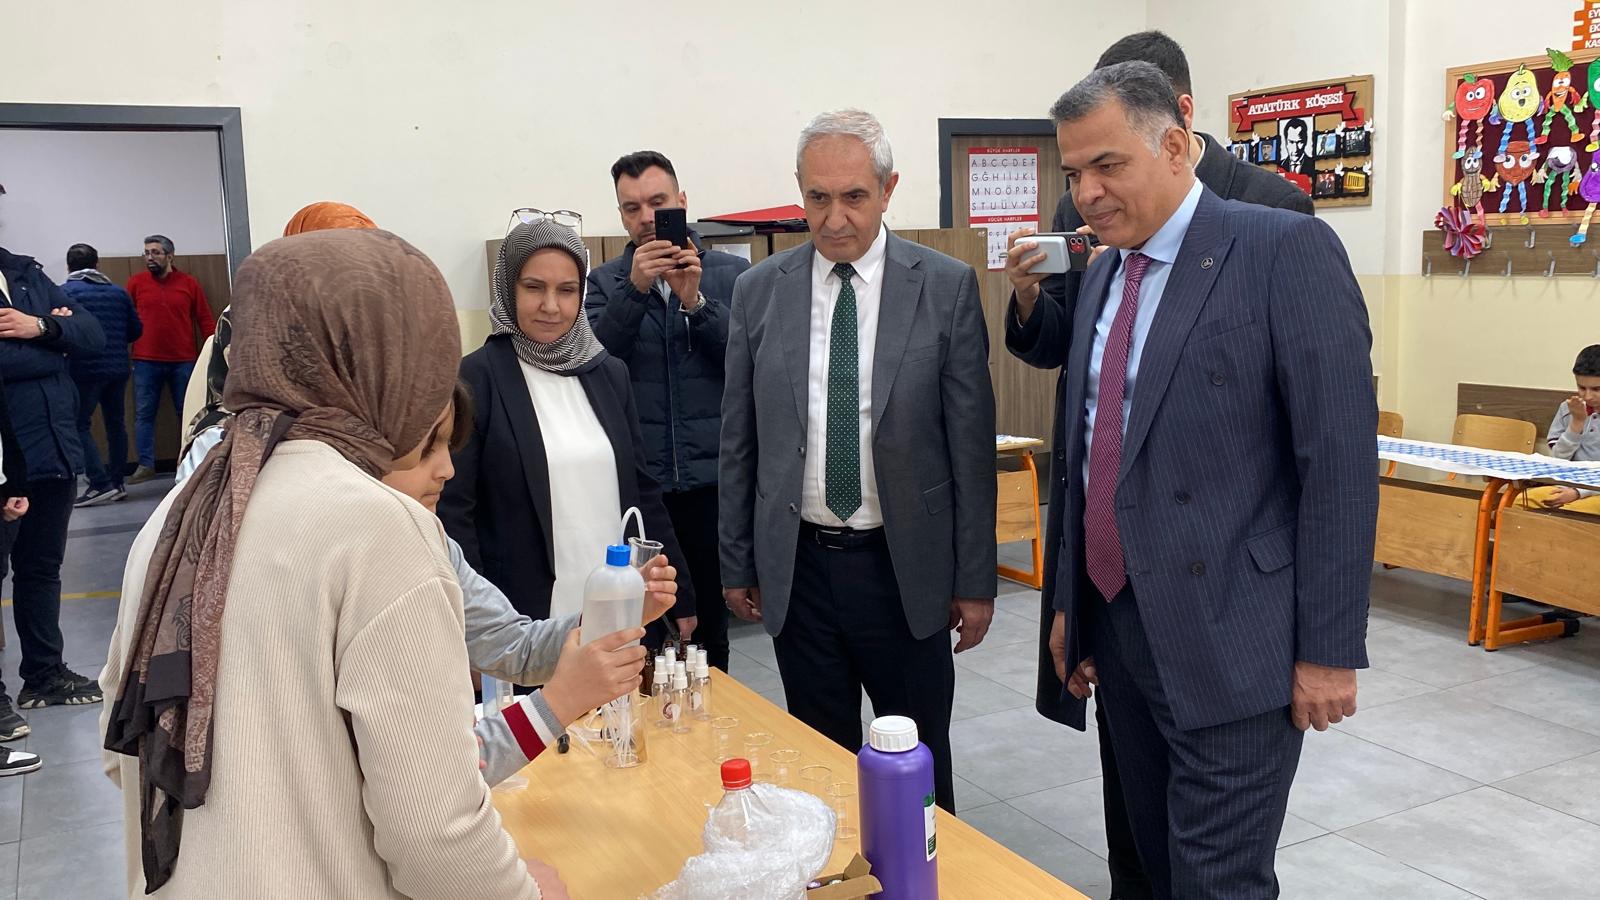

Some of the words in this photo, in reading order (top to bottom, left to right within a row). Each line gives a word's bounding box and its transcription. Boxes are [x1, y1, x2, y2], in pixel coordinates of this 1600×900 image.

[1588, 8, 1600, 18] EY
[1248, 98, 1300, 115] ATATÜRK
[1305, 91, 1344, 108] KÖŞESİ
[982, 159, 986, 167] B
[993, 173, 998, 181] H
[1016, 186, 1019, 194] P
